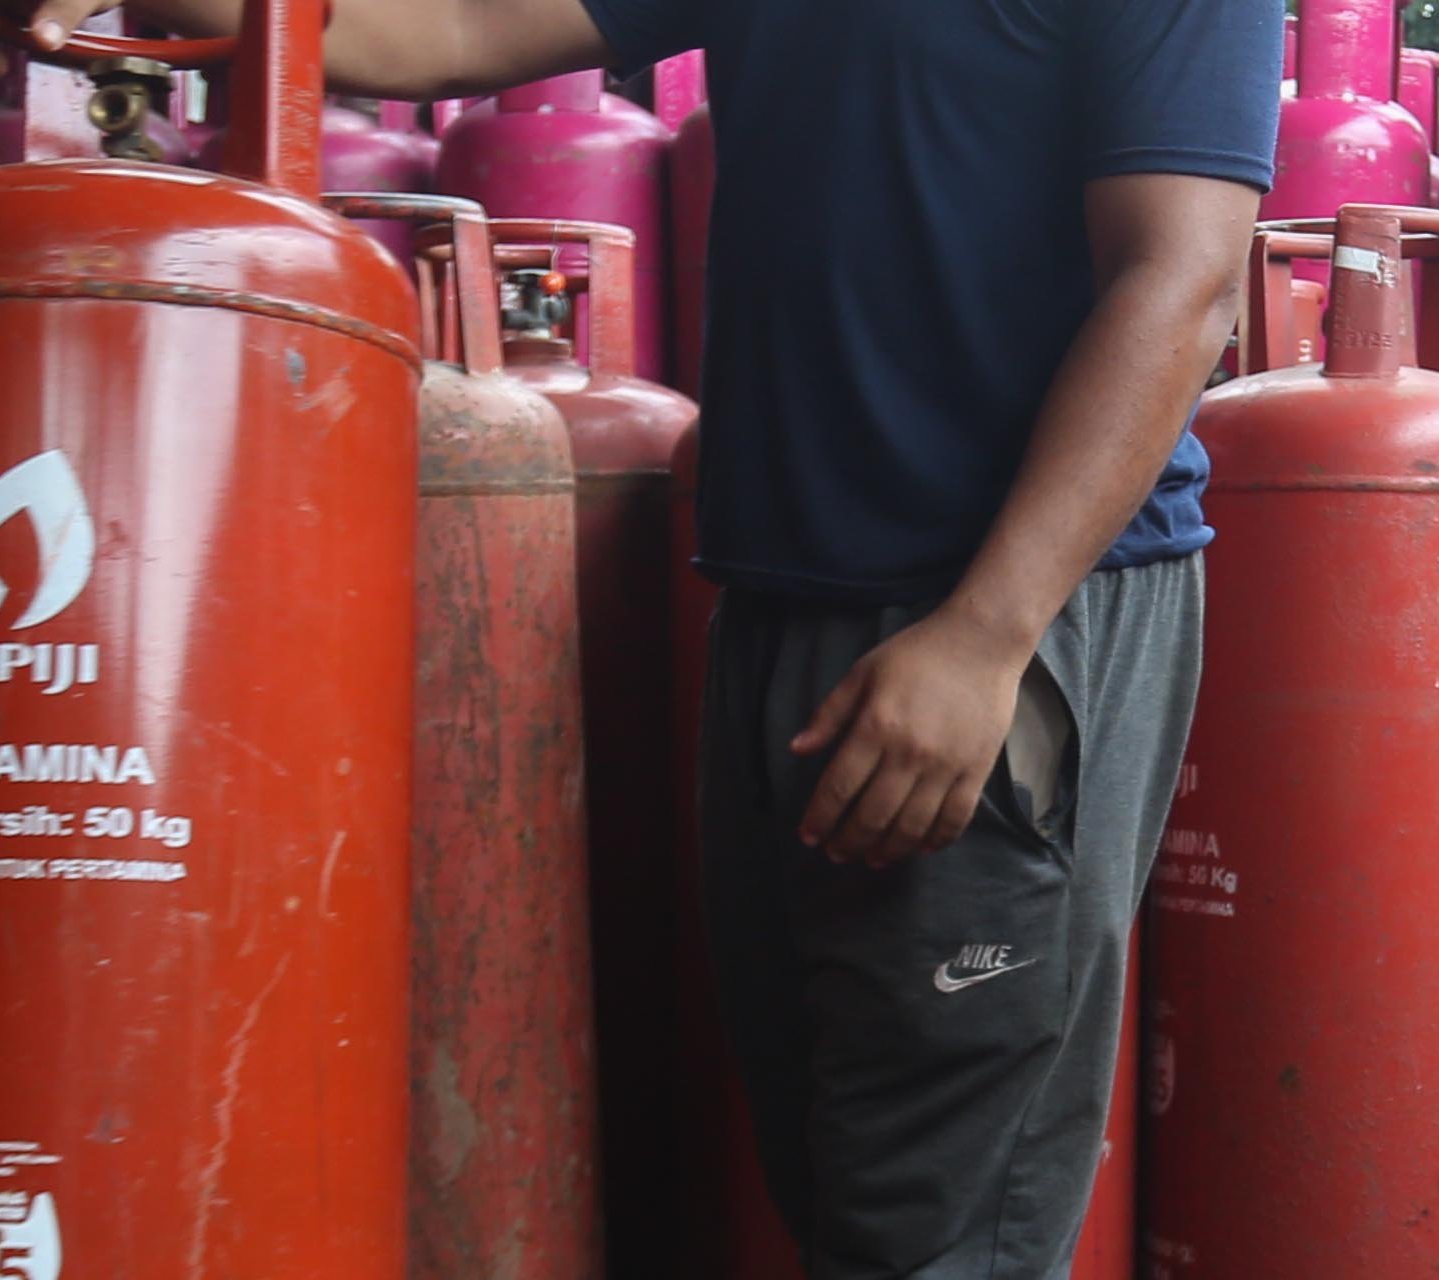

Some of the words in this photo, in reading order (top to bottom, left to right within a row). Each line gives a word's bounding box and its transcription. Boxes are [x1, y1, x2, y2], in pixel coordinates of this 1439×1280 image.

[83, 806, 134, 838] 50
[139, 808, 192, 848] kg
[955, 944, 1013, 969] NIKE
